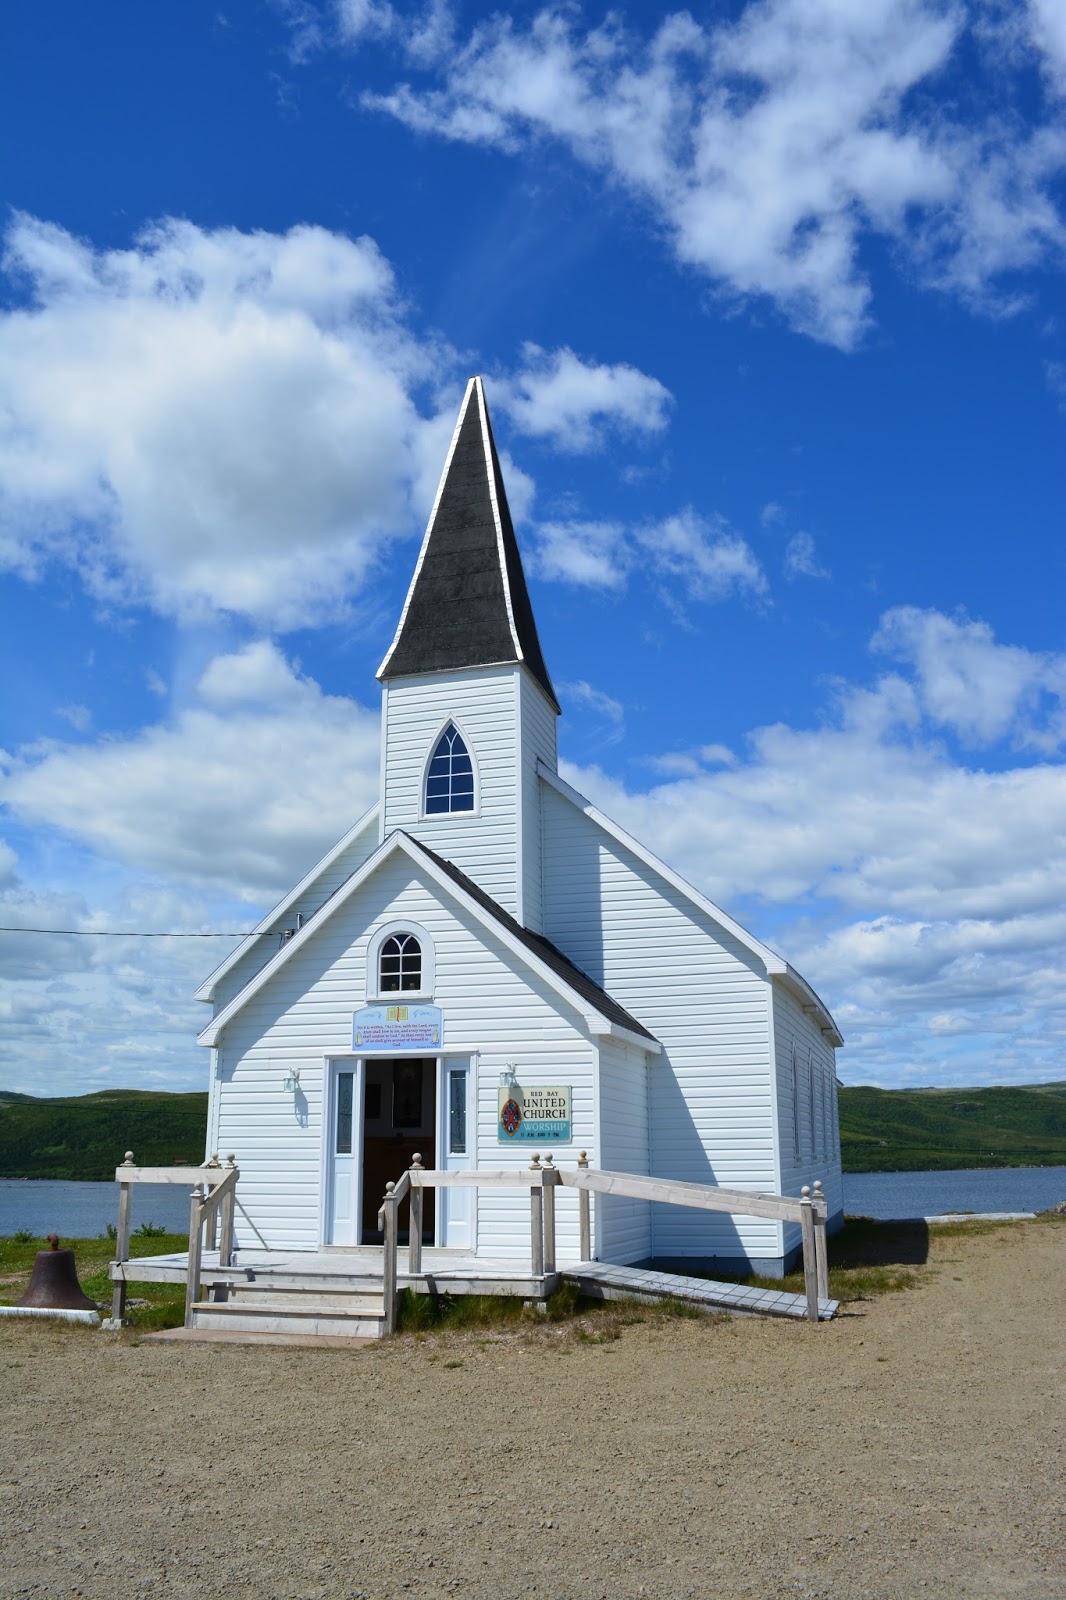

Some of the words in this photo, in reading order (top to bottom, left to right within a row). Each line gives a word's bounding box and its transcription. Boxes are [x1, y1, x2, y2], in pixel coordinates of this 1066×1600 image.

[523, 1098, 566, 1108] UNITED
[523, 1109, 566, 1118] CHURCH
[523, 1123, 566, 1131] WORSHIP
